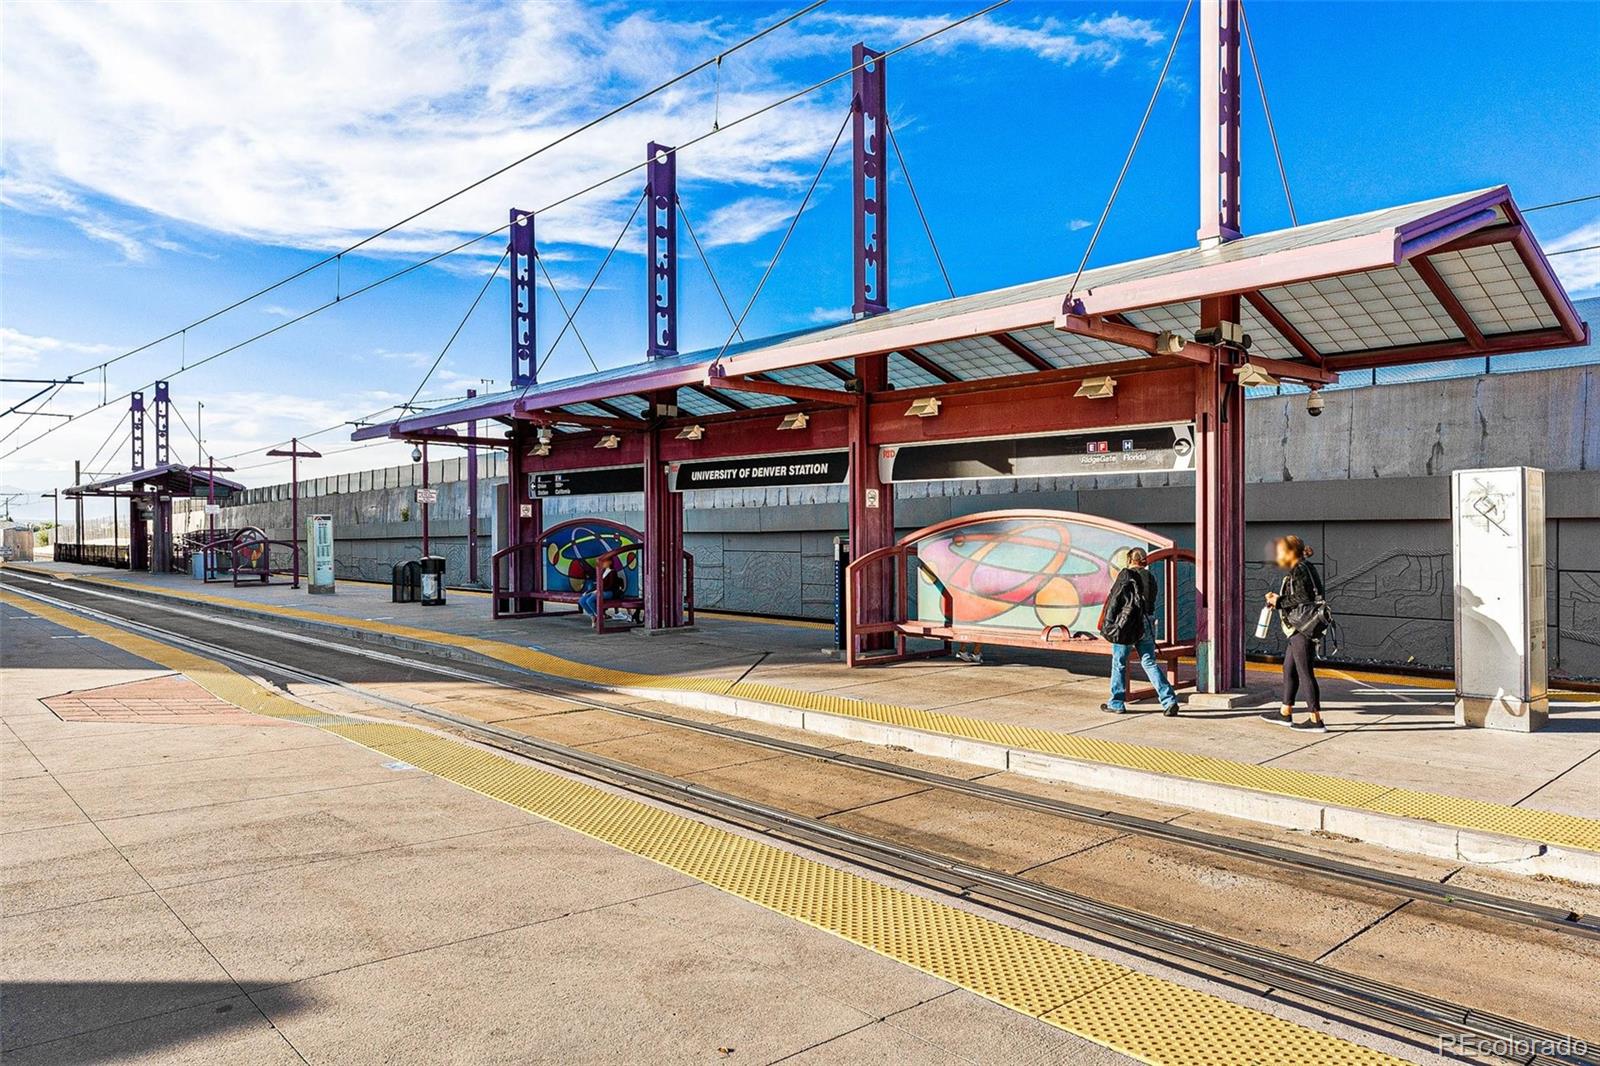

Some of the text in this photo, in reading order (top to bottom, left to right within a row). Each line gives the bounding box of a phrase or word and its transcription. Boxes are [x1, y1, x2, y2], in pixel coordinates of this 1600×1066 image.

[1123, 452, 1147, 461] Florida
[691, 467, 738, 481] UNIVERSITY
[739, 467, 751, 479] OF
[751, 465, 787, 478] DENVER
[788, 463, 829, 476] STATION
